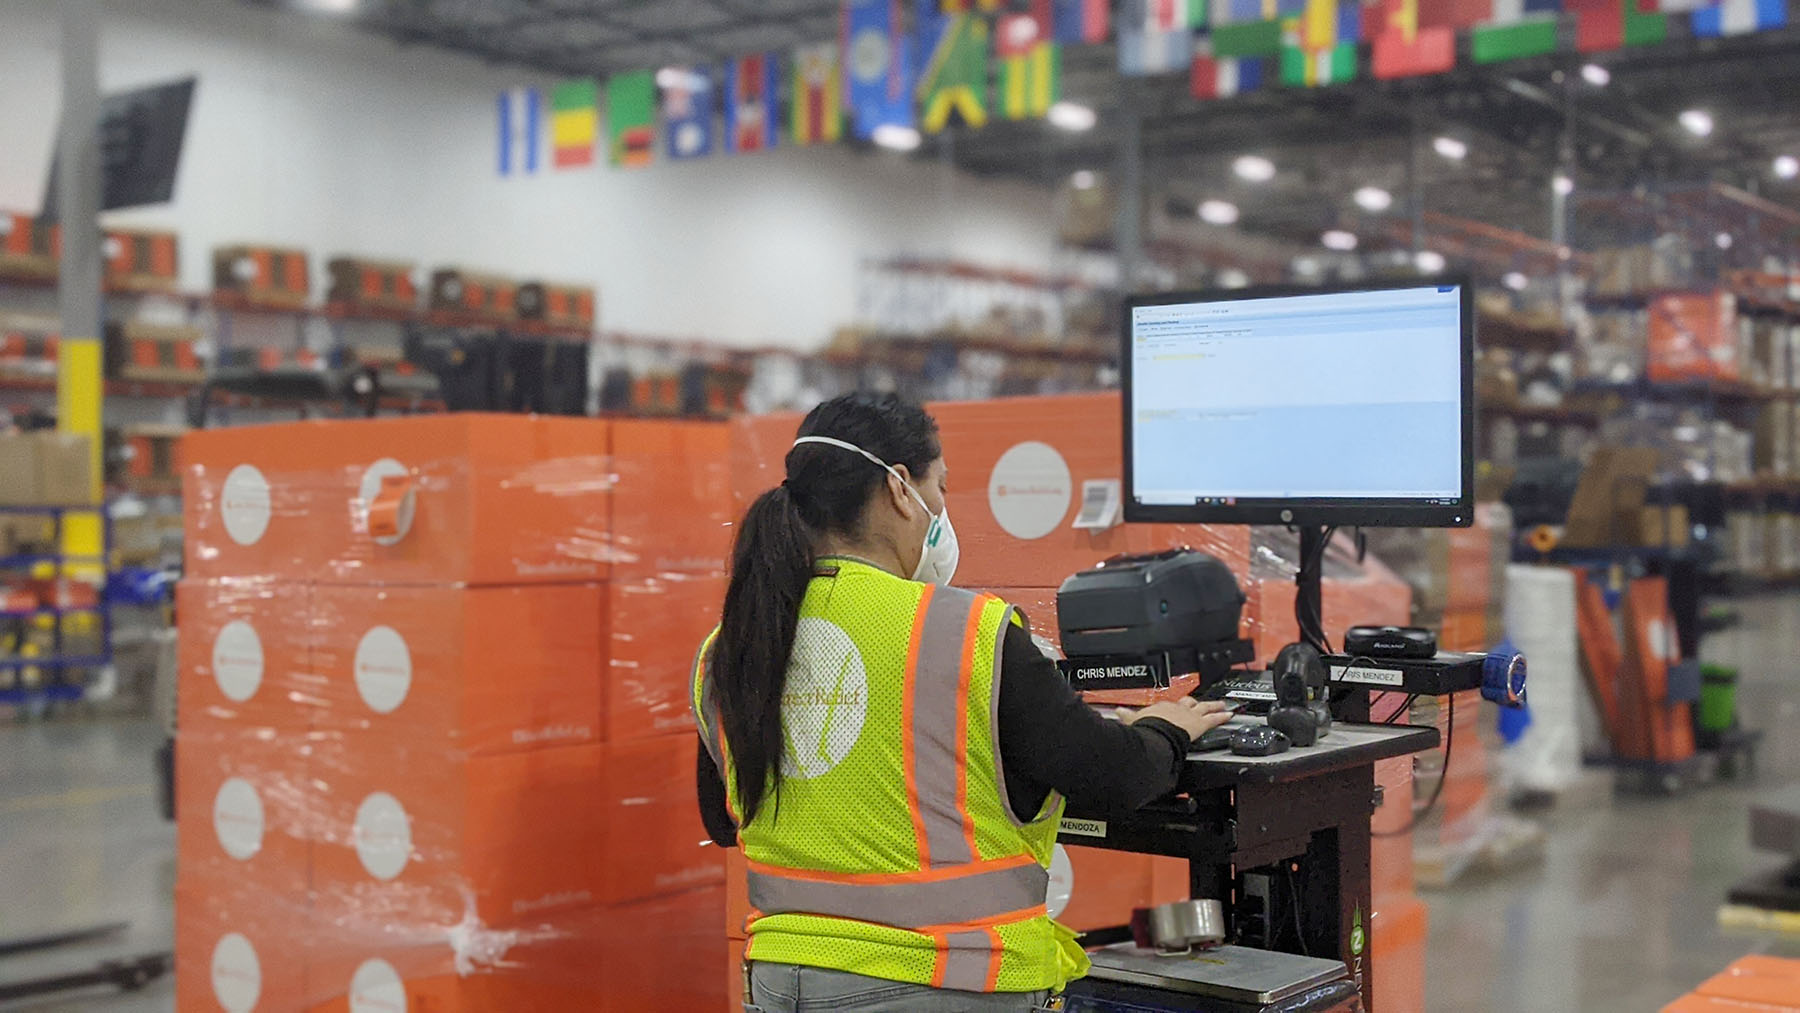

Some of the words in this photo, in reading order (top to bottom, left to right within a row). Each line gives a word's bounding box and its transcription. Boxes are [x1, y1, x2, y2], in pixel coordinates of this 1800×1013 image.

[1077, 667, 1105, 680] CHRIS
[1106, 665, 1147, 678] MENDEZ
[1337, 670, 1361, 679] CRIS
[1363, 671, 1396, 681] MENDEZ
[1223, 680, 1271, 690] Nucleus
[1060, 821, 1100, 833] MENDOZA
